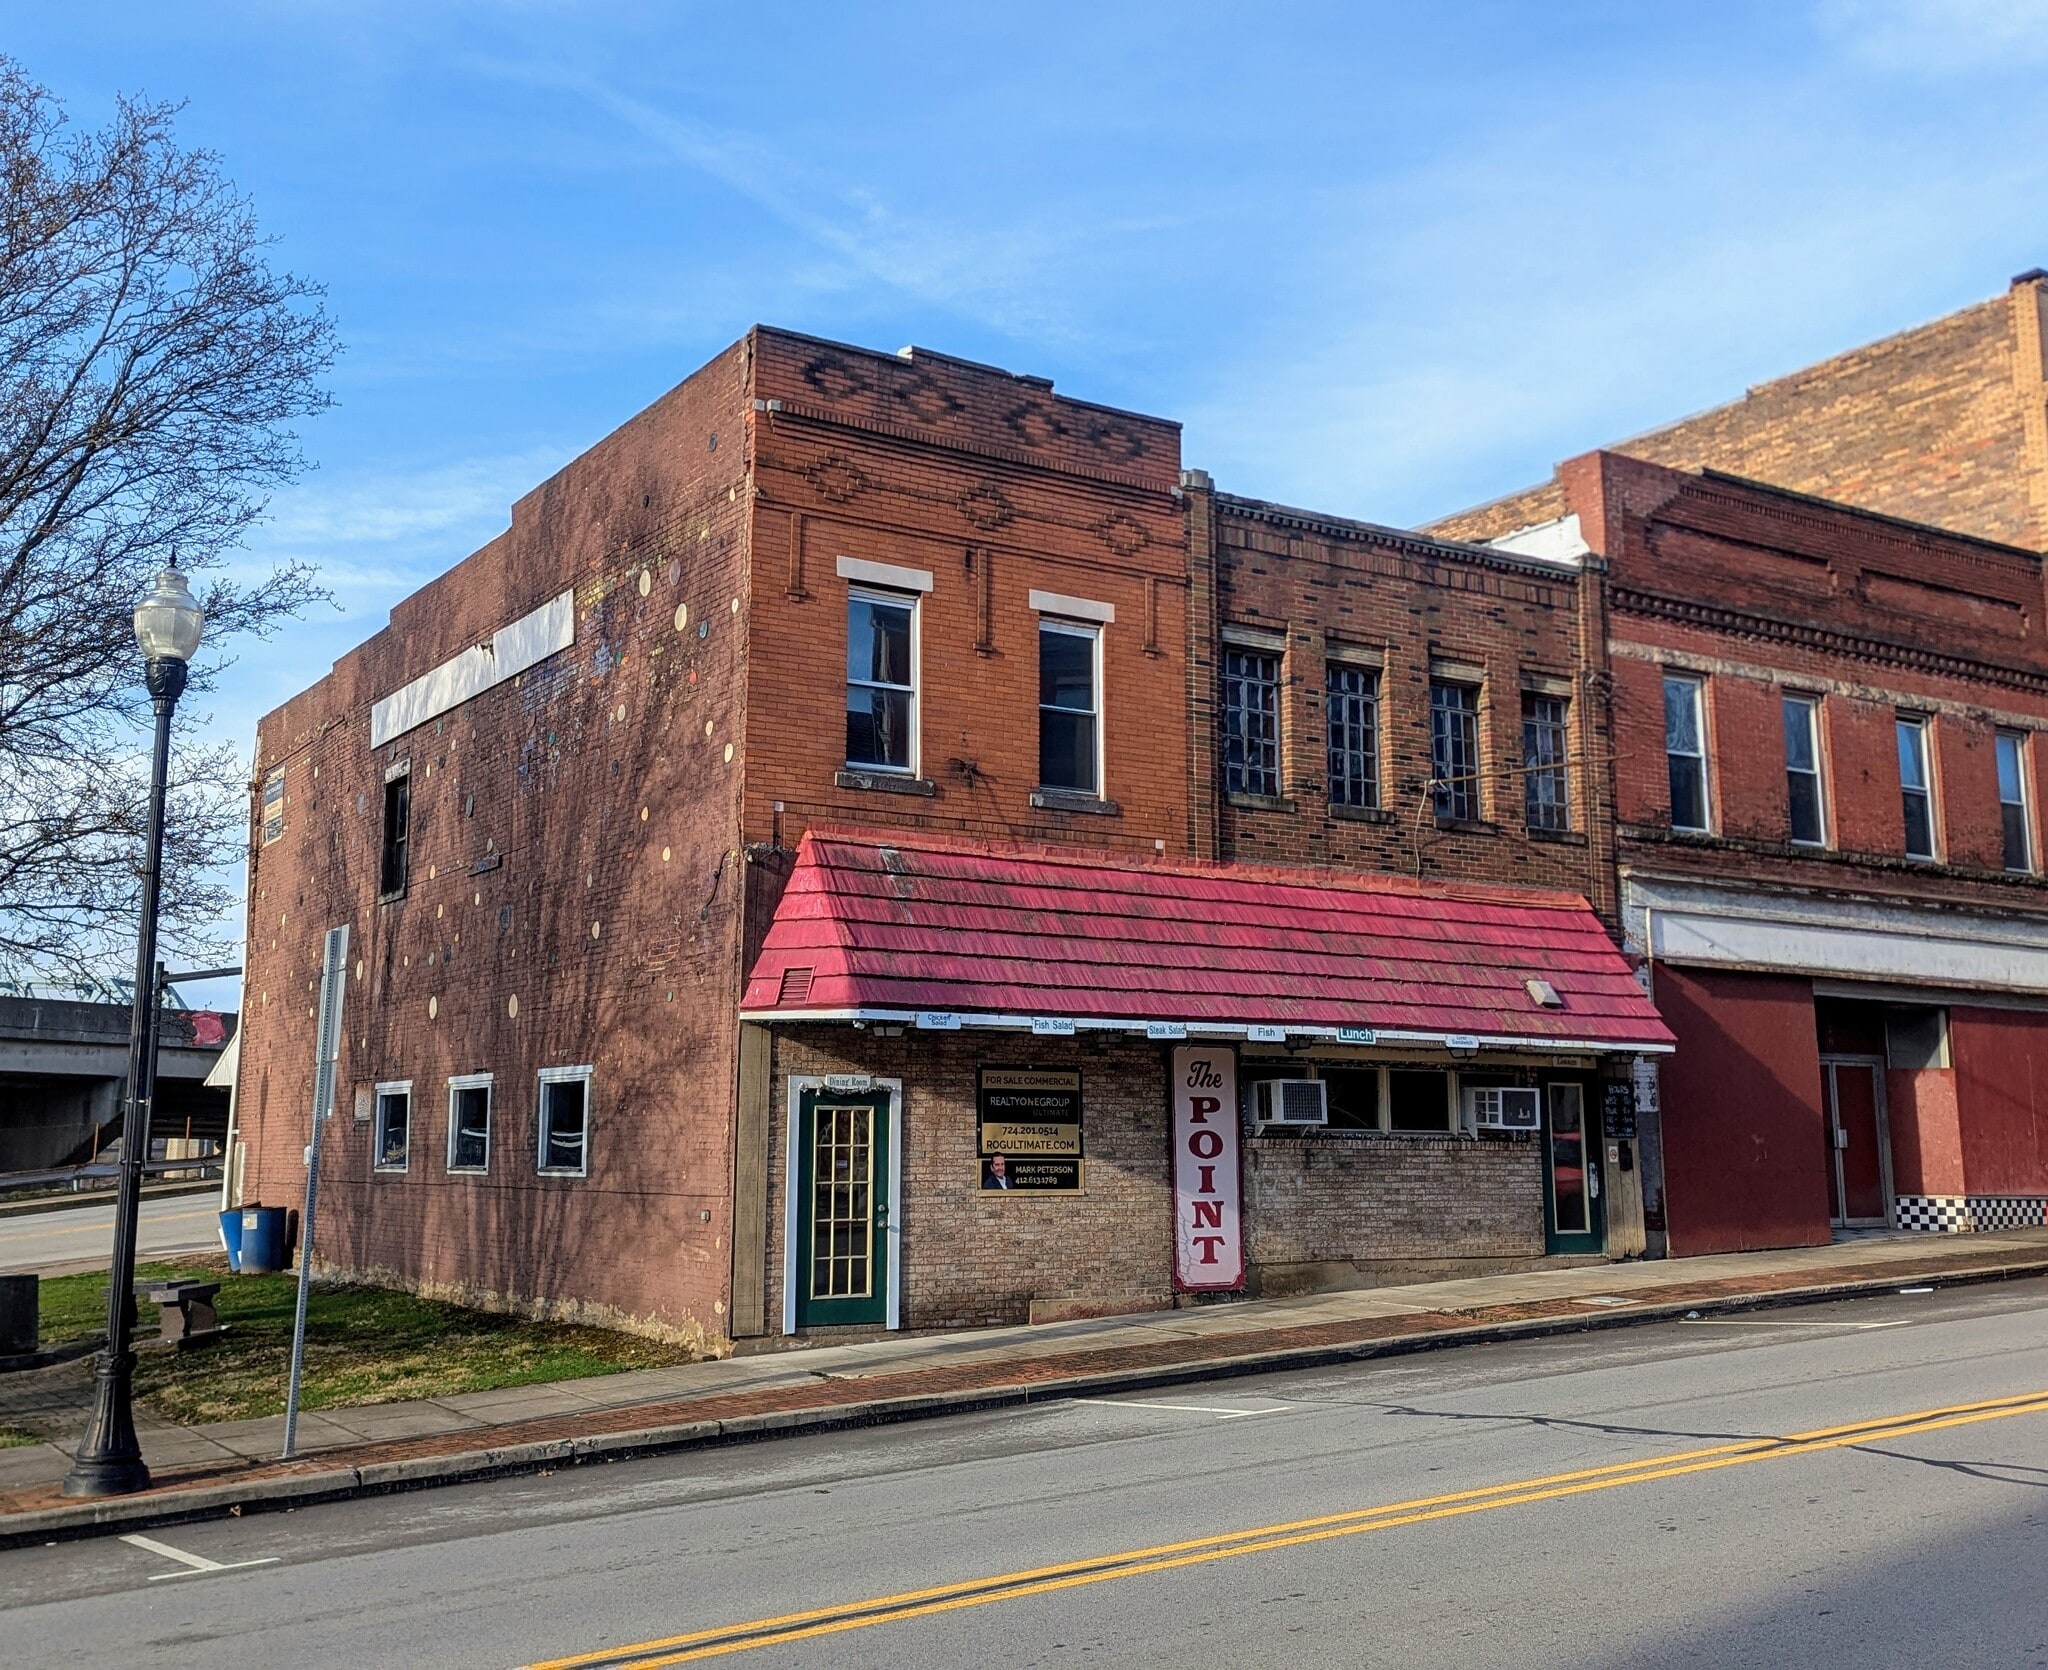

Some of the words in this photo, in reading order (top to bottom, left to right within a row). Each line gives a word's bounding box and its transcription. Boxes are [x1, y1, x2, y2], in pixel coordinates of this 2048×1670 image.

[1034, 1019, 1050, 1030] Fish
[1052, 1019, 1073, 1031] Salad
[1149, 1025, 1167, 1035] Steak
[1168, 1025, 1185, 1035] Salad
[1258, 1027, 1276, 1038] Fish
[1340, 1027, 1372, 1041] Lunch
[1187, 1060, 1223, 1089] The
[830, 1076, 850, 1087] Dining
[852, 1077, 869, 1087] Room
[985, 1076, 1002, 1084] FOR
[1003, 1077, 1023, 1085] SALE
[1024, 1077, 1076, 1086] COMMERCIAL
[1032, 1109, 1069, 1117] ULTIMATE
[1002, 1126, 1059, 1136] 724.201.0514
[986, 1140, 1075, 1149] ROGULTIMATE.COM
[1015, 1166, 1036, 1174] MARK
[1037, 1166, 1073, 1174] PETERSON
[1188, 1097, 1226, 1264] POINT
